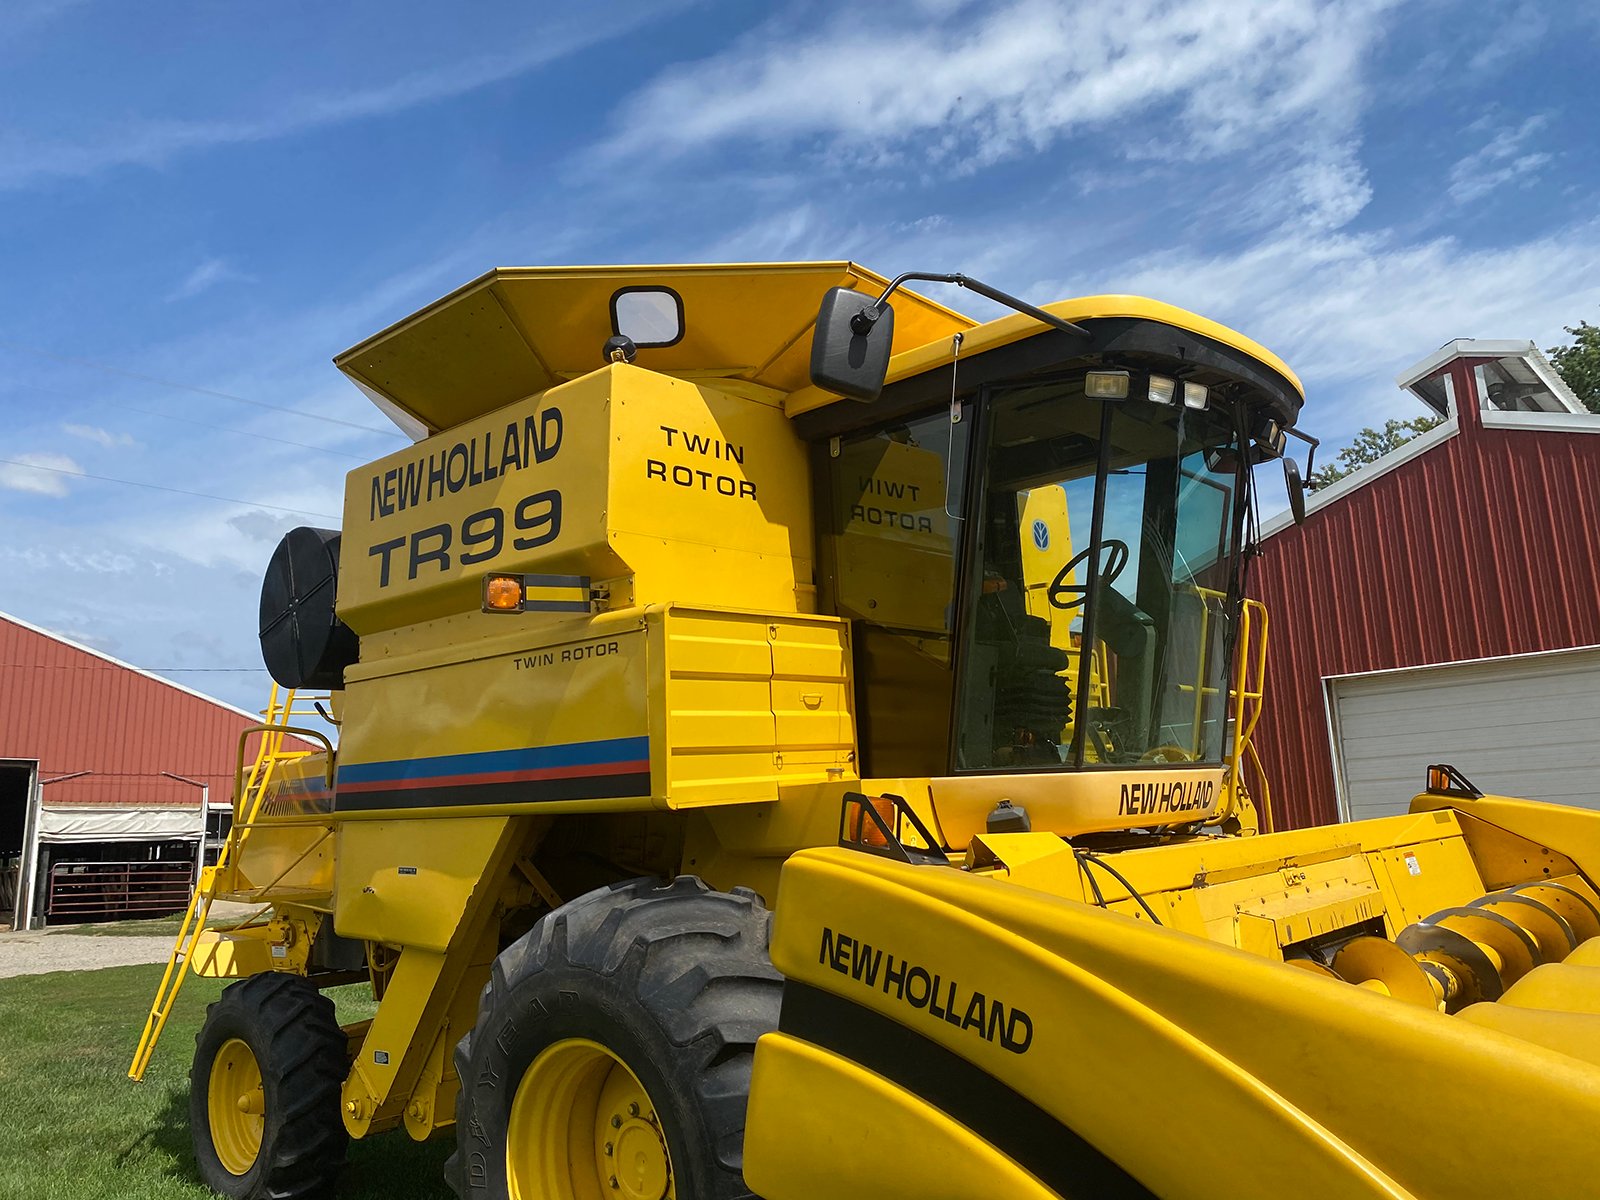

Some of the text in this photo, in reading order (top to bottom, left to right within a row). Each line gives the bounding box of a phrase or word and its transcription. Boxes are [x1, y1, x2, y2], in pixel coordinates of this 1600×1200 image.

[370, 407, 563, 521] NEW HOLLAND
[660, 425, 744, 464] TWIN
[647, 459, 757, 501] ROTOR
[368, 489, 562, 588] TR99
[513, 641, 619, 670] TWIN ROTOR
[1118, 780, 1213, 816] NEW HOLLAND
[819, 926, 1034, 1055] NEW HOLLAND
